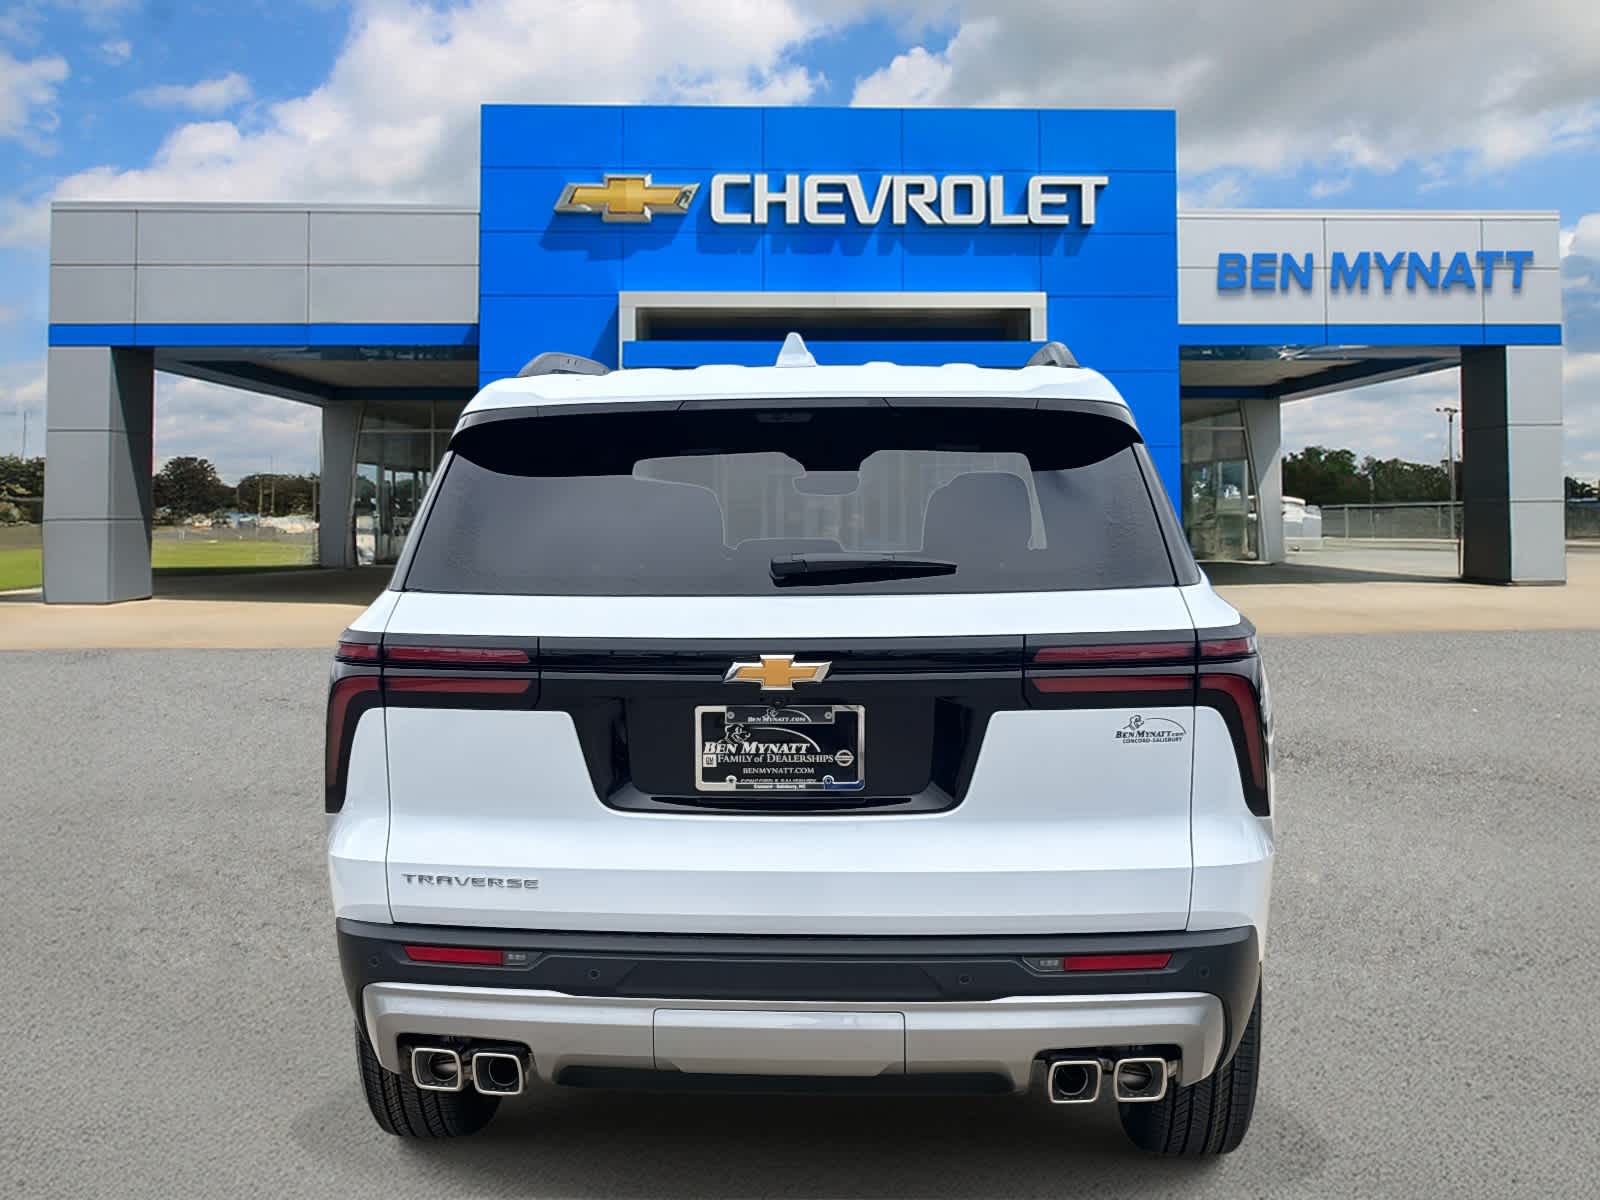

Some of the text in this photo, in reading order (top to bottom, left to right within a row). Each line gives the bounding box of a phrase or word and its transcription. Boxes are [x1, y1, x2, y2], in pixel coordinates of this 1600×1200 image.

[710, 173, 1109, 225] CHEVROLET
[1217, 250, 1534, 291] BEN MYNATT
[704, 742, 811, 754] BEN MYNATT
[717, 754, 834, 763] FAMILY of DEALERSHIPS
[402, 873, 539, 889] TRAVERSE
